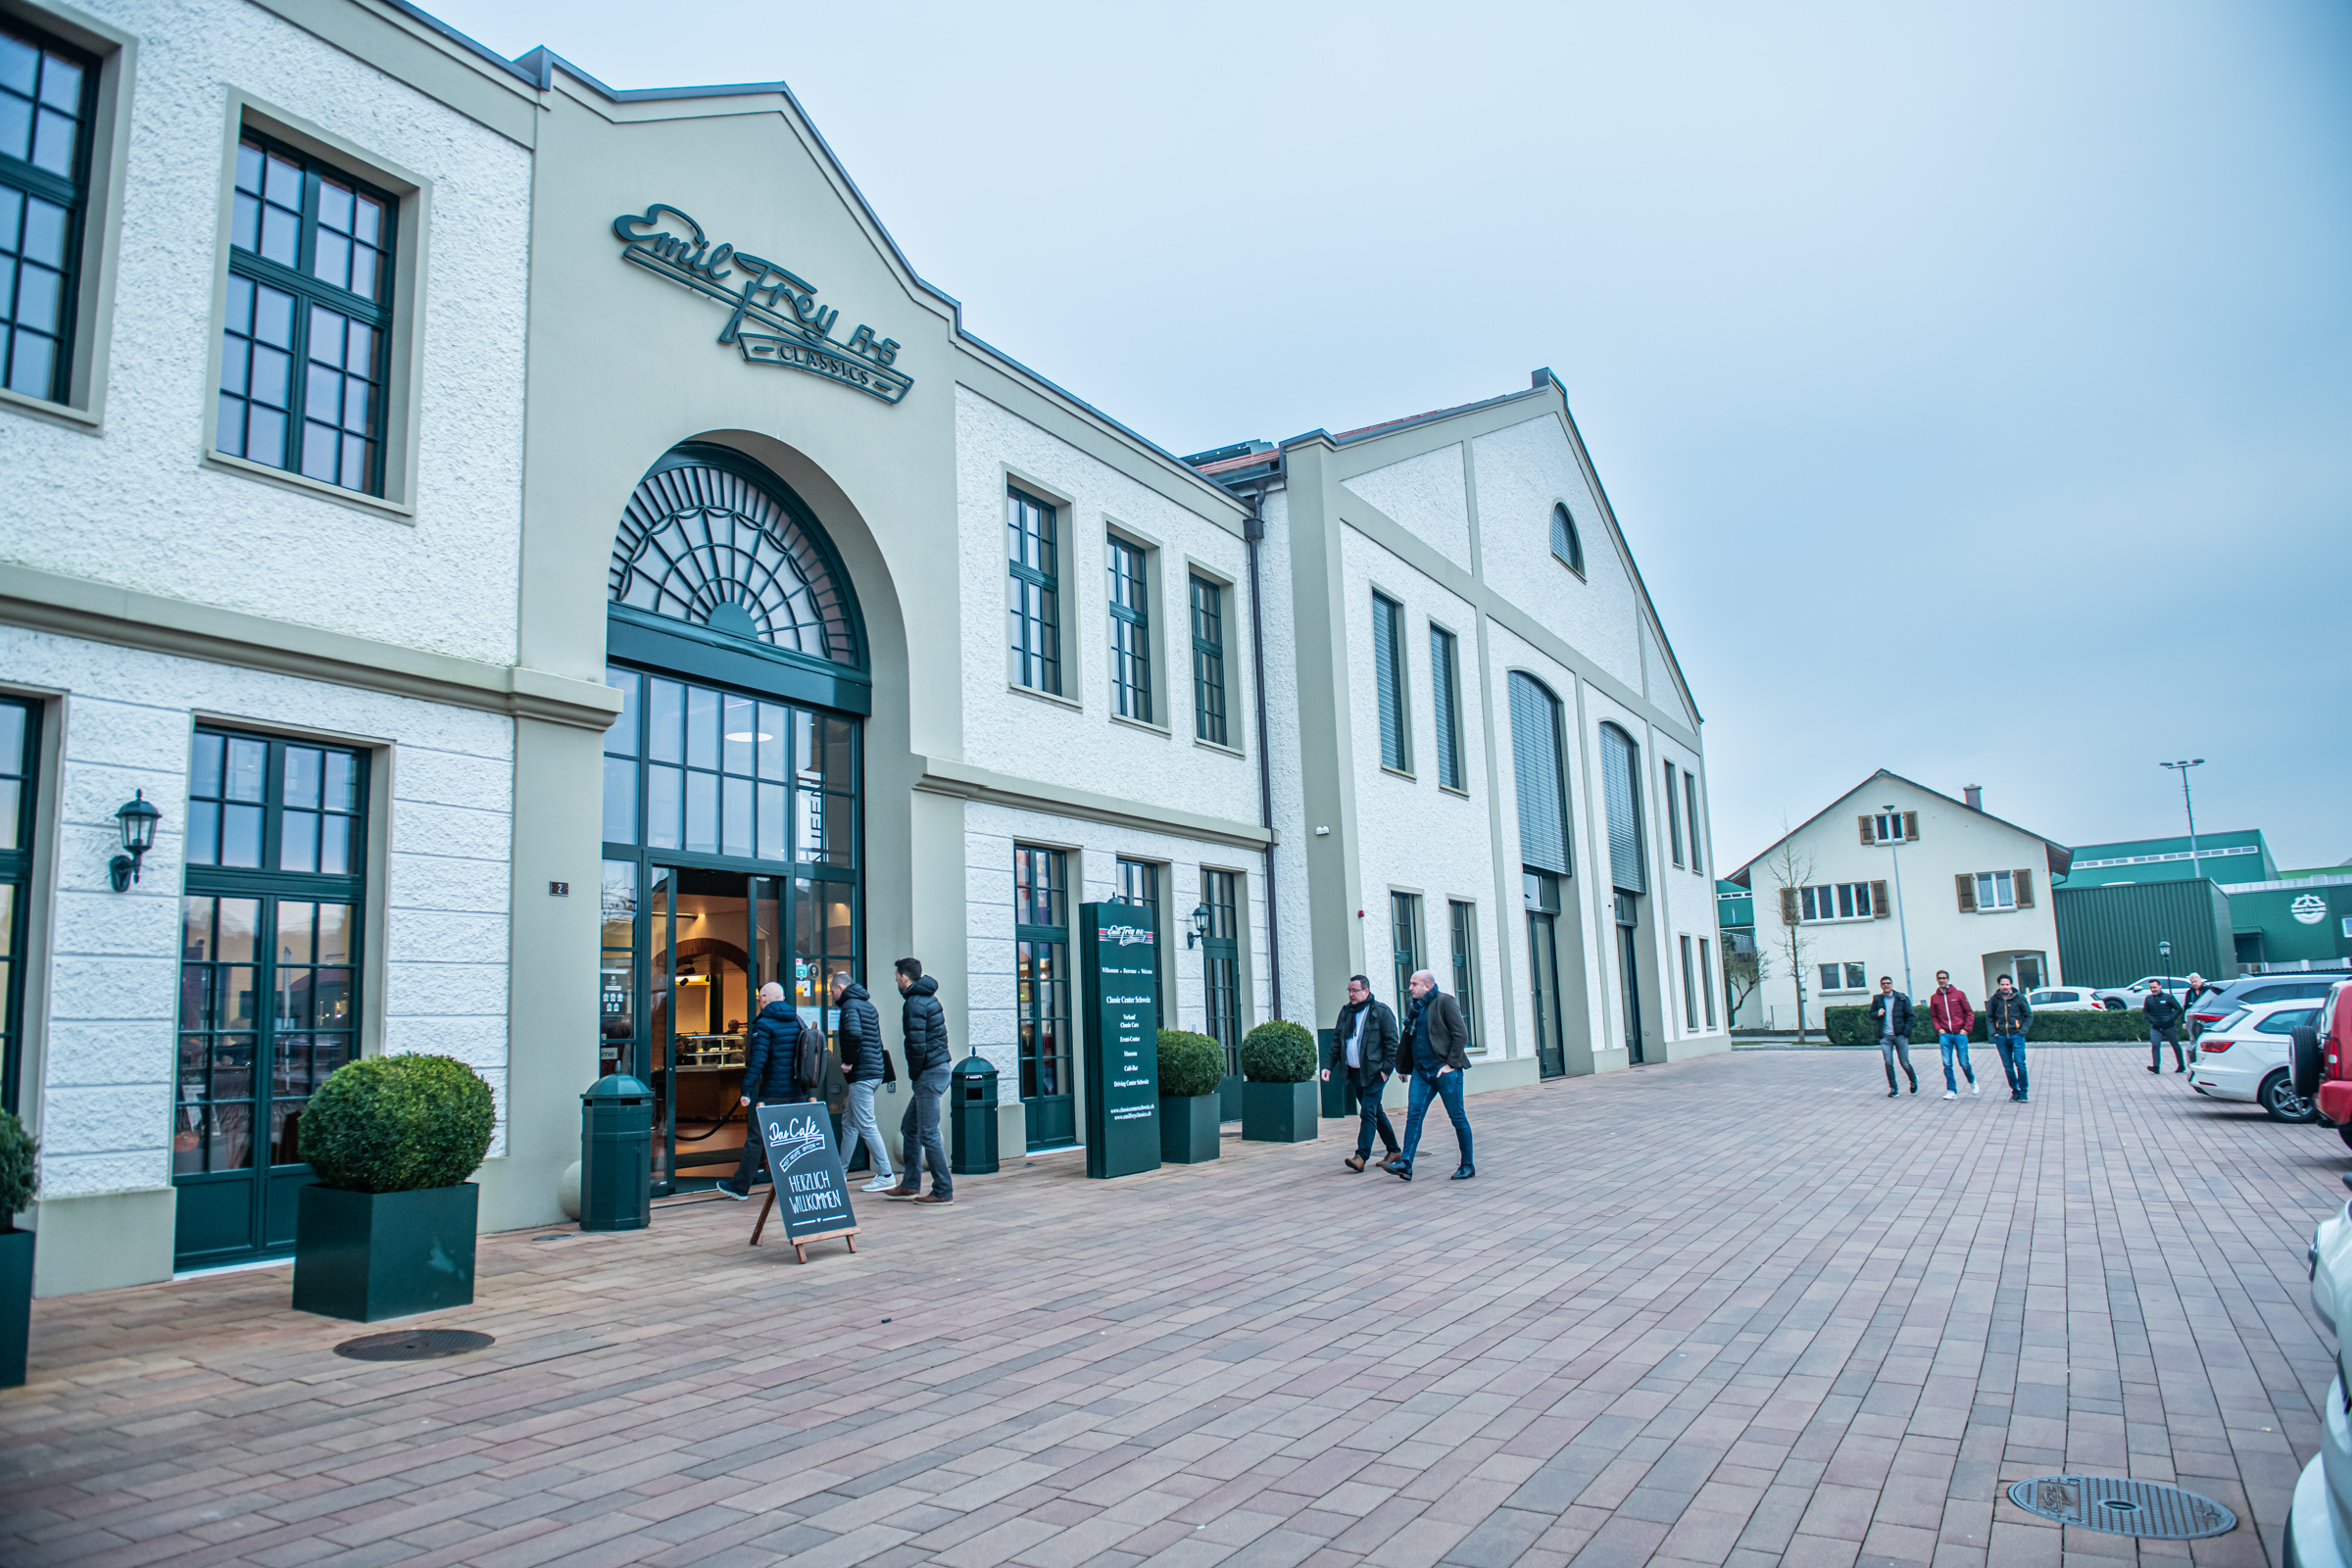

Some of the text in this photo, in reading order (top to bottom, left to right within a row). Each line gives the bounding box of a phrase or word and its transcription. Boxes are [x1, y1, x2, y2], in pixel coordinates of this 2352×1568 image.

[612, 203, 733, 281] Emil
[717, 251, 840, 344] Frey
[779, 345, 870, 386] CLASSICS
[558, 883, 563, 894] 2
[769, 1115, 820, 1143] Das Café
[788, 1170, 831, 1193] HERZLICH
[789, 1189, 842, 1214] WILLKOMMEN
